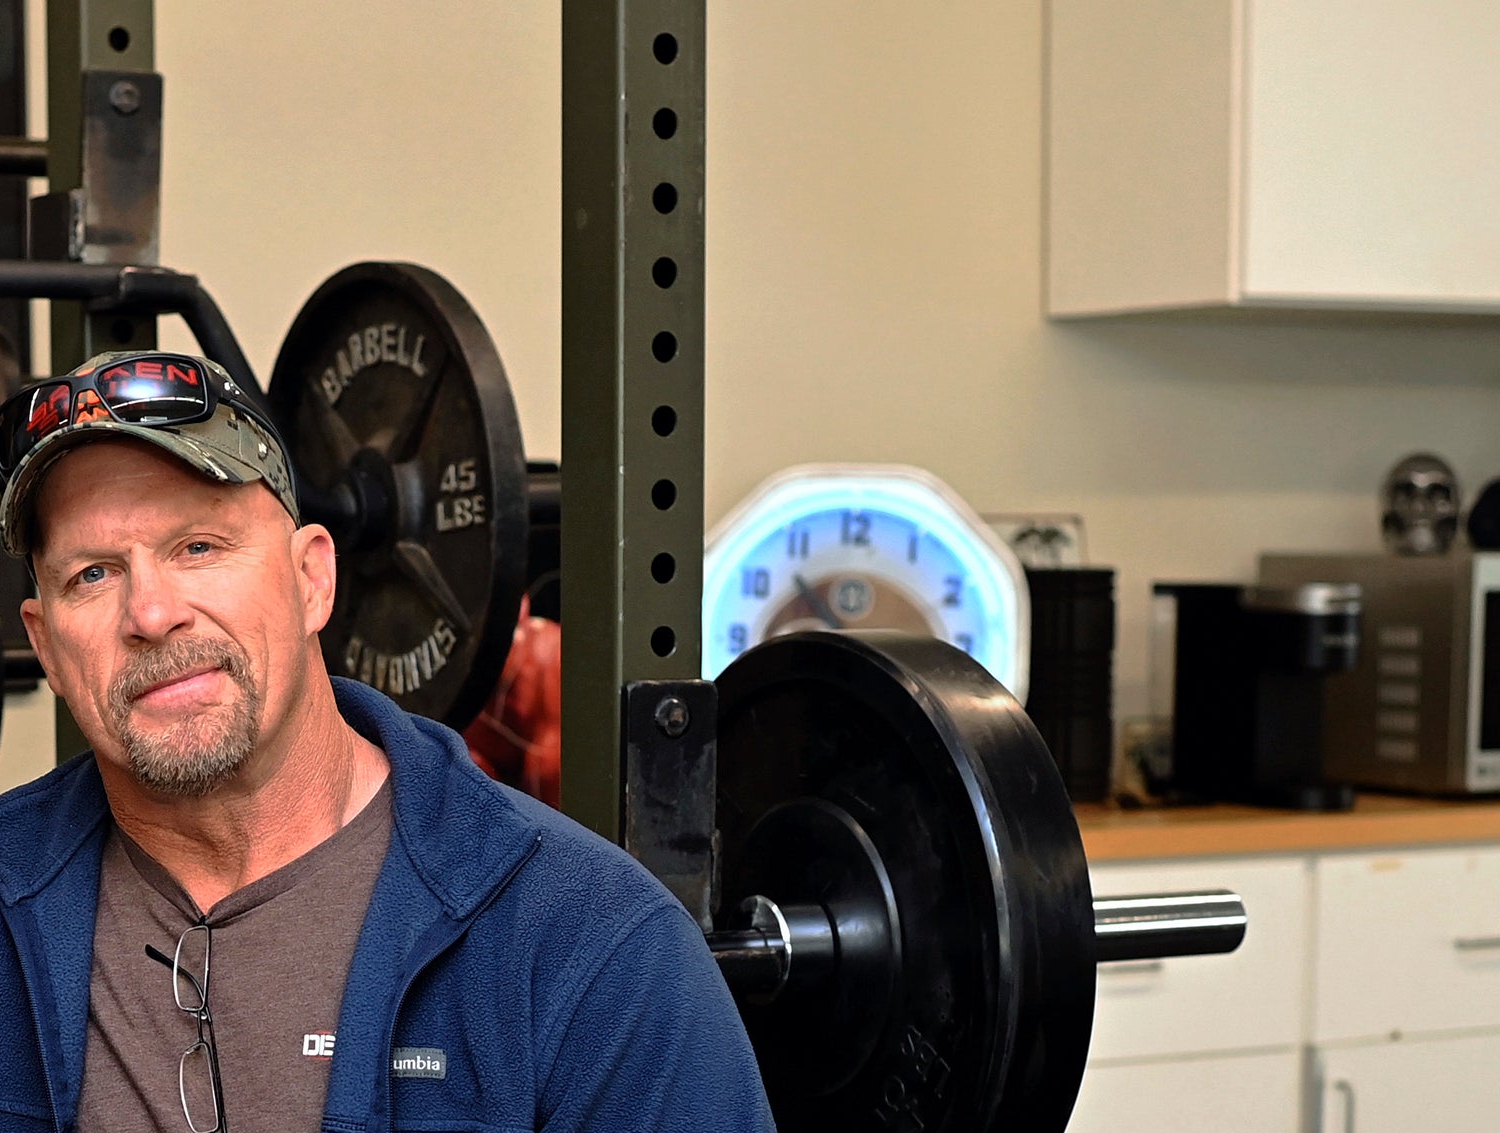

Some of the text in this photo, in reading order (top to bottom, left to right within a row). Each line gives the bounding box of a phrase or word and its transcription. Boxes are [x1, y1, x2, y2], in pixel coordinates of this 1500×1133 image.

[320, 323, 428, 405] BARBELL
[439, 460, 477, 493] 45
[435, 495, 487, 532] LBS
[841, 512, 870, 547] 12
[788, 526, 809, 561] 11
[908, 532, 919, 565] 1
[742, 567, 770, 599] 10
[943, 575, 963, 608] 2
[302, 1033, 336, 1056] DE
[393, 1055, 441, 1071] umbia
